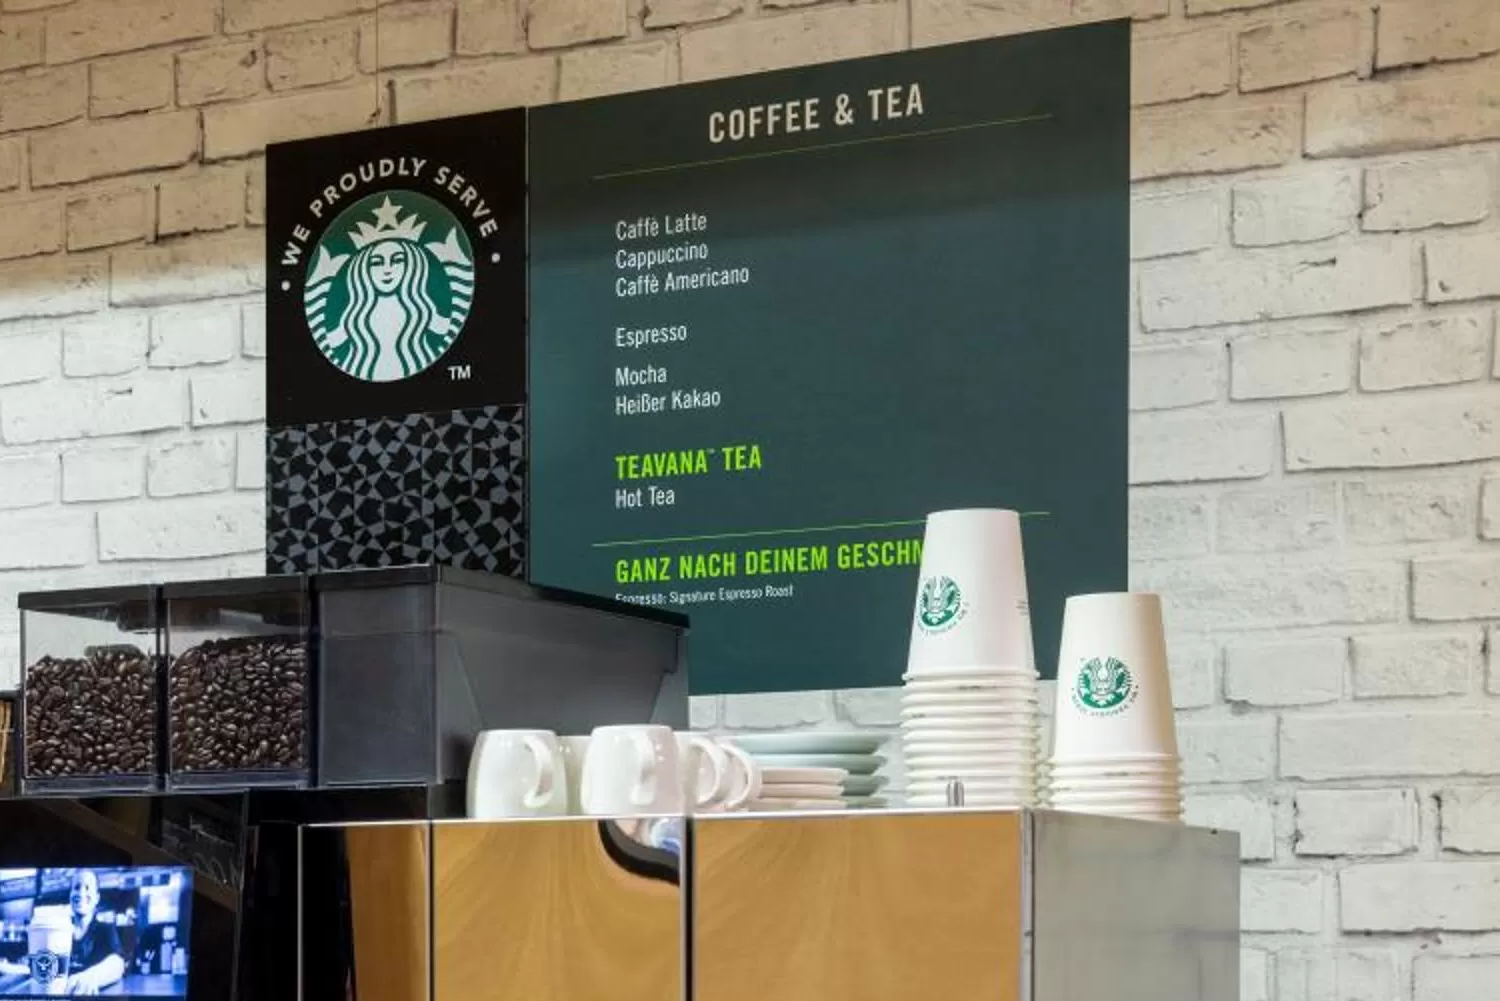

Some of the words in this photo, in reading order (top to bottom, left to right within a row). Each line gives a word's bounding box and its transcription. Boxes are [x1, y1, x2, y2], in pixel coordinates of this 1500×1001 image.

[709, 98, 821, 144] COFFEE
[834, 93, 855, 127] &
[868, 83, 925, 122] TEA
[281, 223, 312, 265] WE
[309, 157, 427, 218] PROUDLY
[434, 166, 498, 237] SERVE
[615, 217, 660, 241] Caffè
[665, 211, 708, 236] Latte
[615, 241, 709, 270] Cappuccino
[615, 274, 660, 298] Caffè
[664, 266, 750, 292] Americano
[615, 325, 688, 348] Espresso
[448, 365, 471, 380] TM
[615, 365, 668, 387] Mocha
[615, 393, 667, 416] Heißer
[671, 389, 722, 411] Kakao
[615, 449, 708, 480] TEAVANA
[722, 444, 763, 471] TEA
[615, 487, 643, 509] Hot
[648, 486, 676, 506] Tea
[616, 556, 671, 584] GANZ
[679, 552, 737, 580] NACH
[745, 545, 828, 576] DEINEM
[669, 590, 716, 606] Signature
[719, 586, 763, 602] Espresso
[765, 584, 794, 598] Roast
